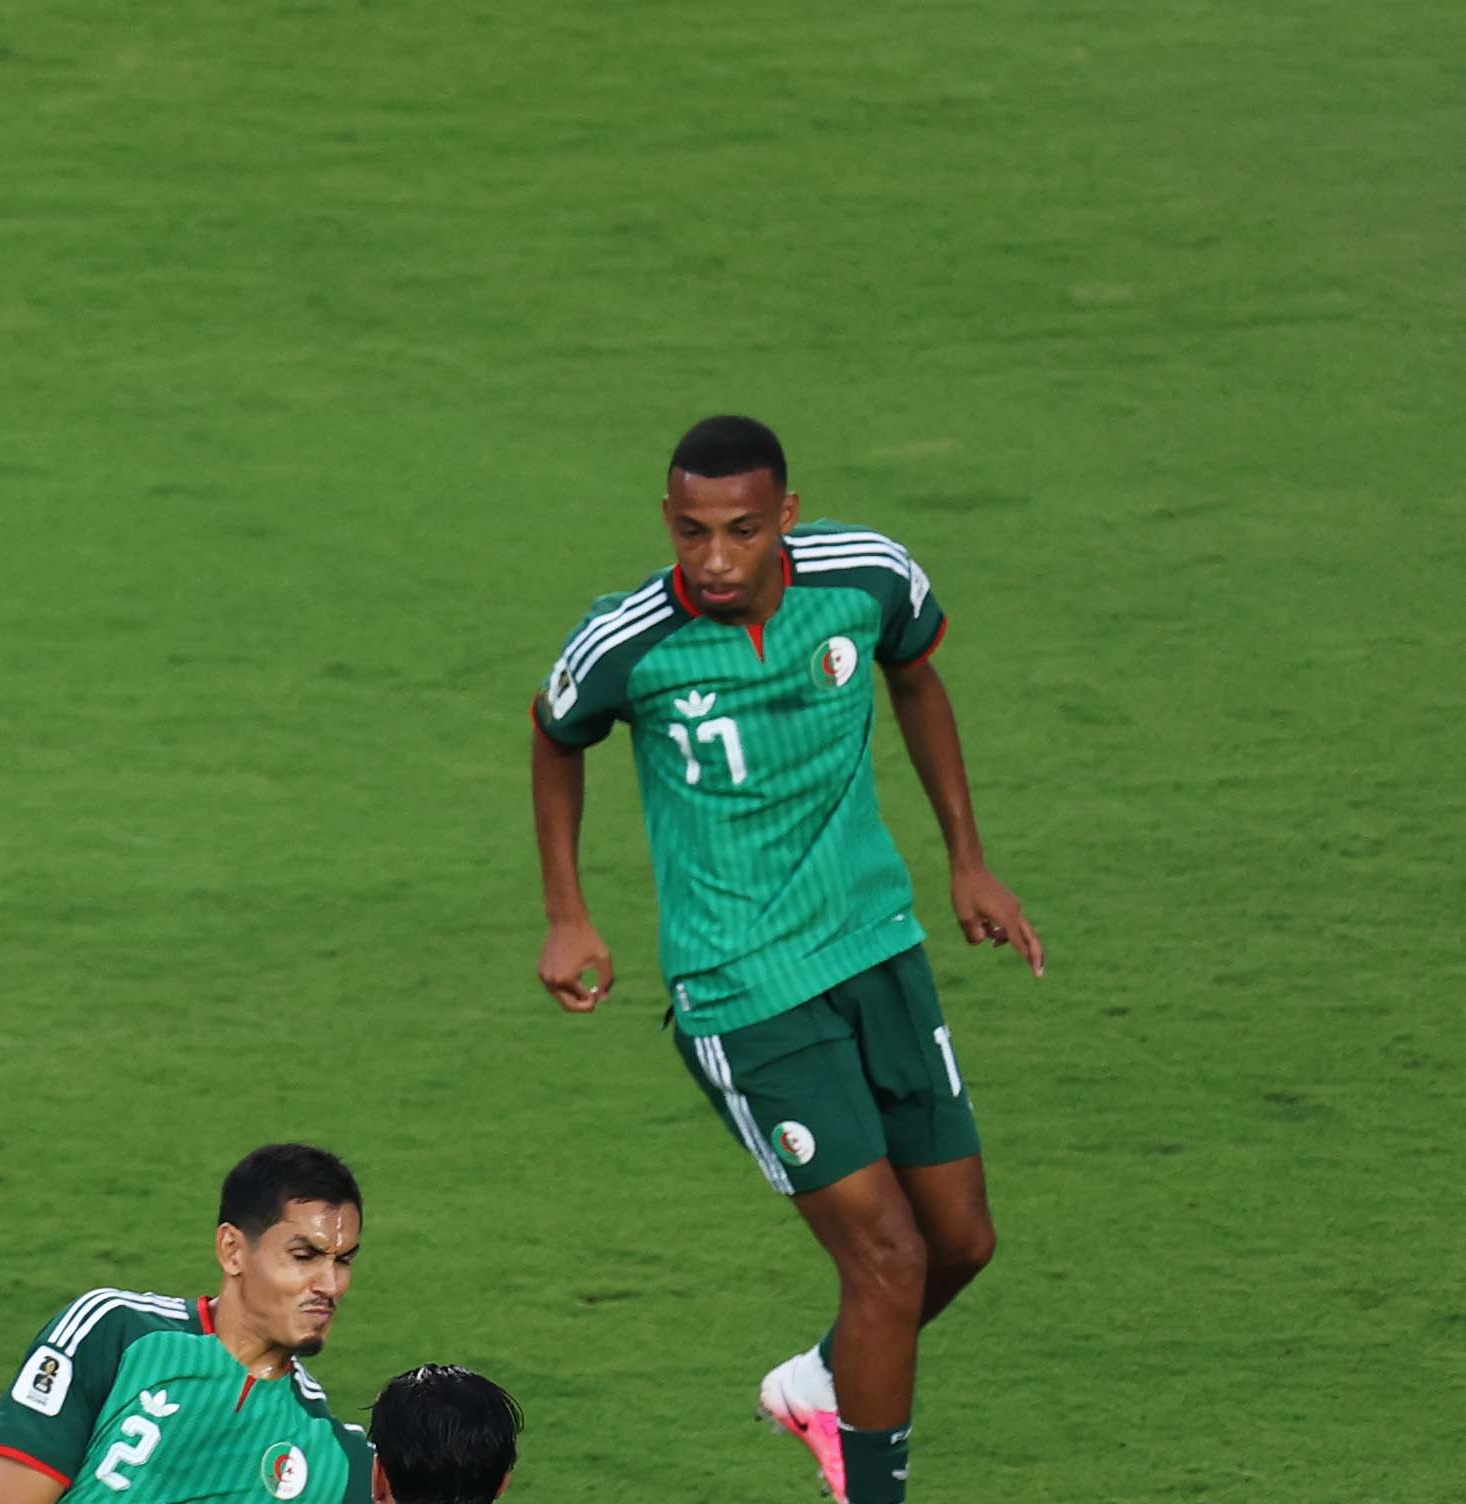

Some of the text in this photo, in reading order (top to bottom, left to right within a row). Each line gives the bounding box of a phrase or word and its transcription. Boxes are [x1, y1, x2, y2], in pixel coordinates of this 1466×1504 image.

[668, 716, 748, 786] 17
[933, 1024, 962, 1098] 1
[95, 1414, 162, 1492] 2
